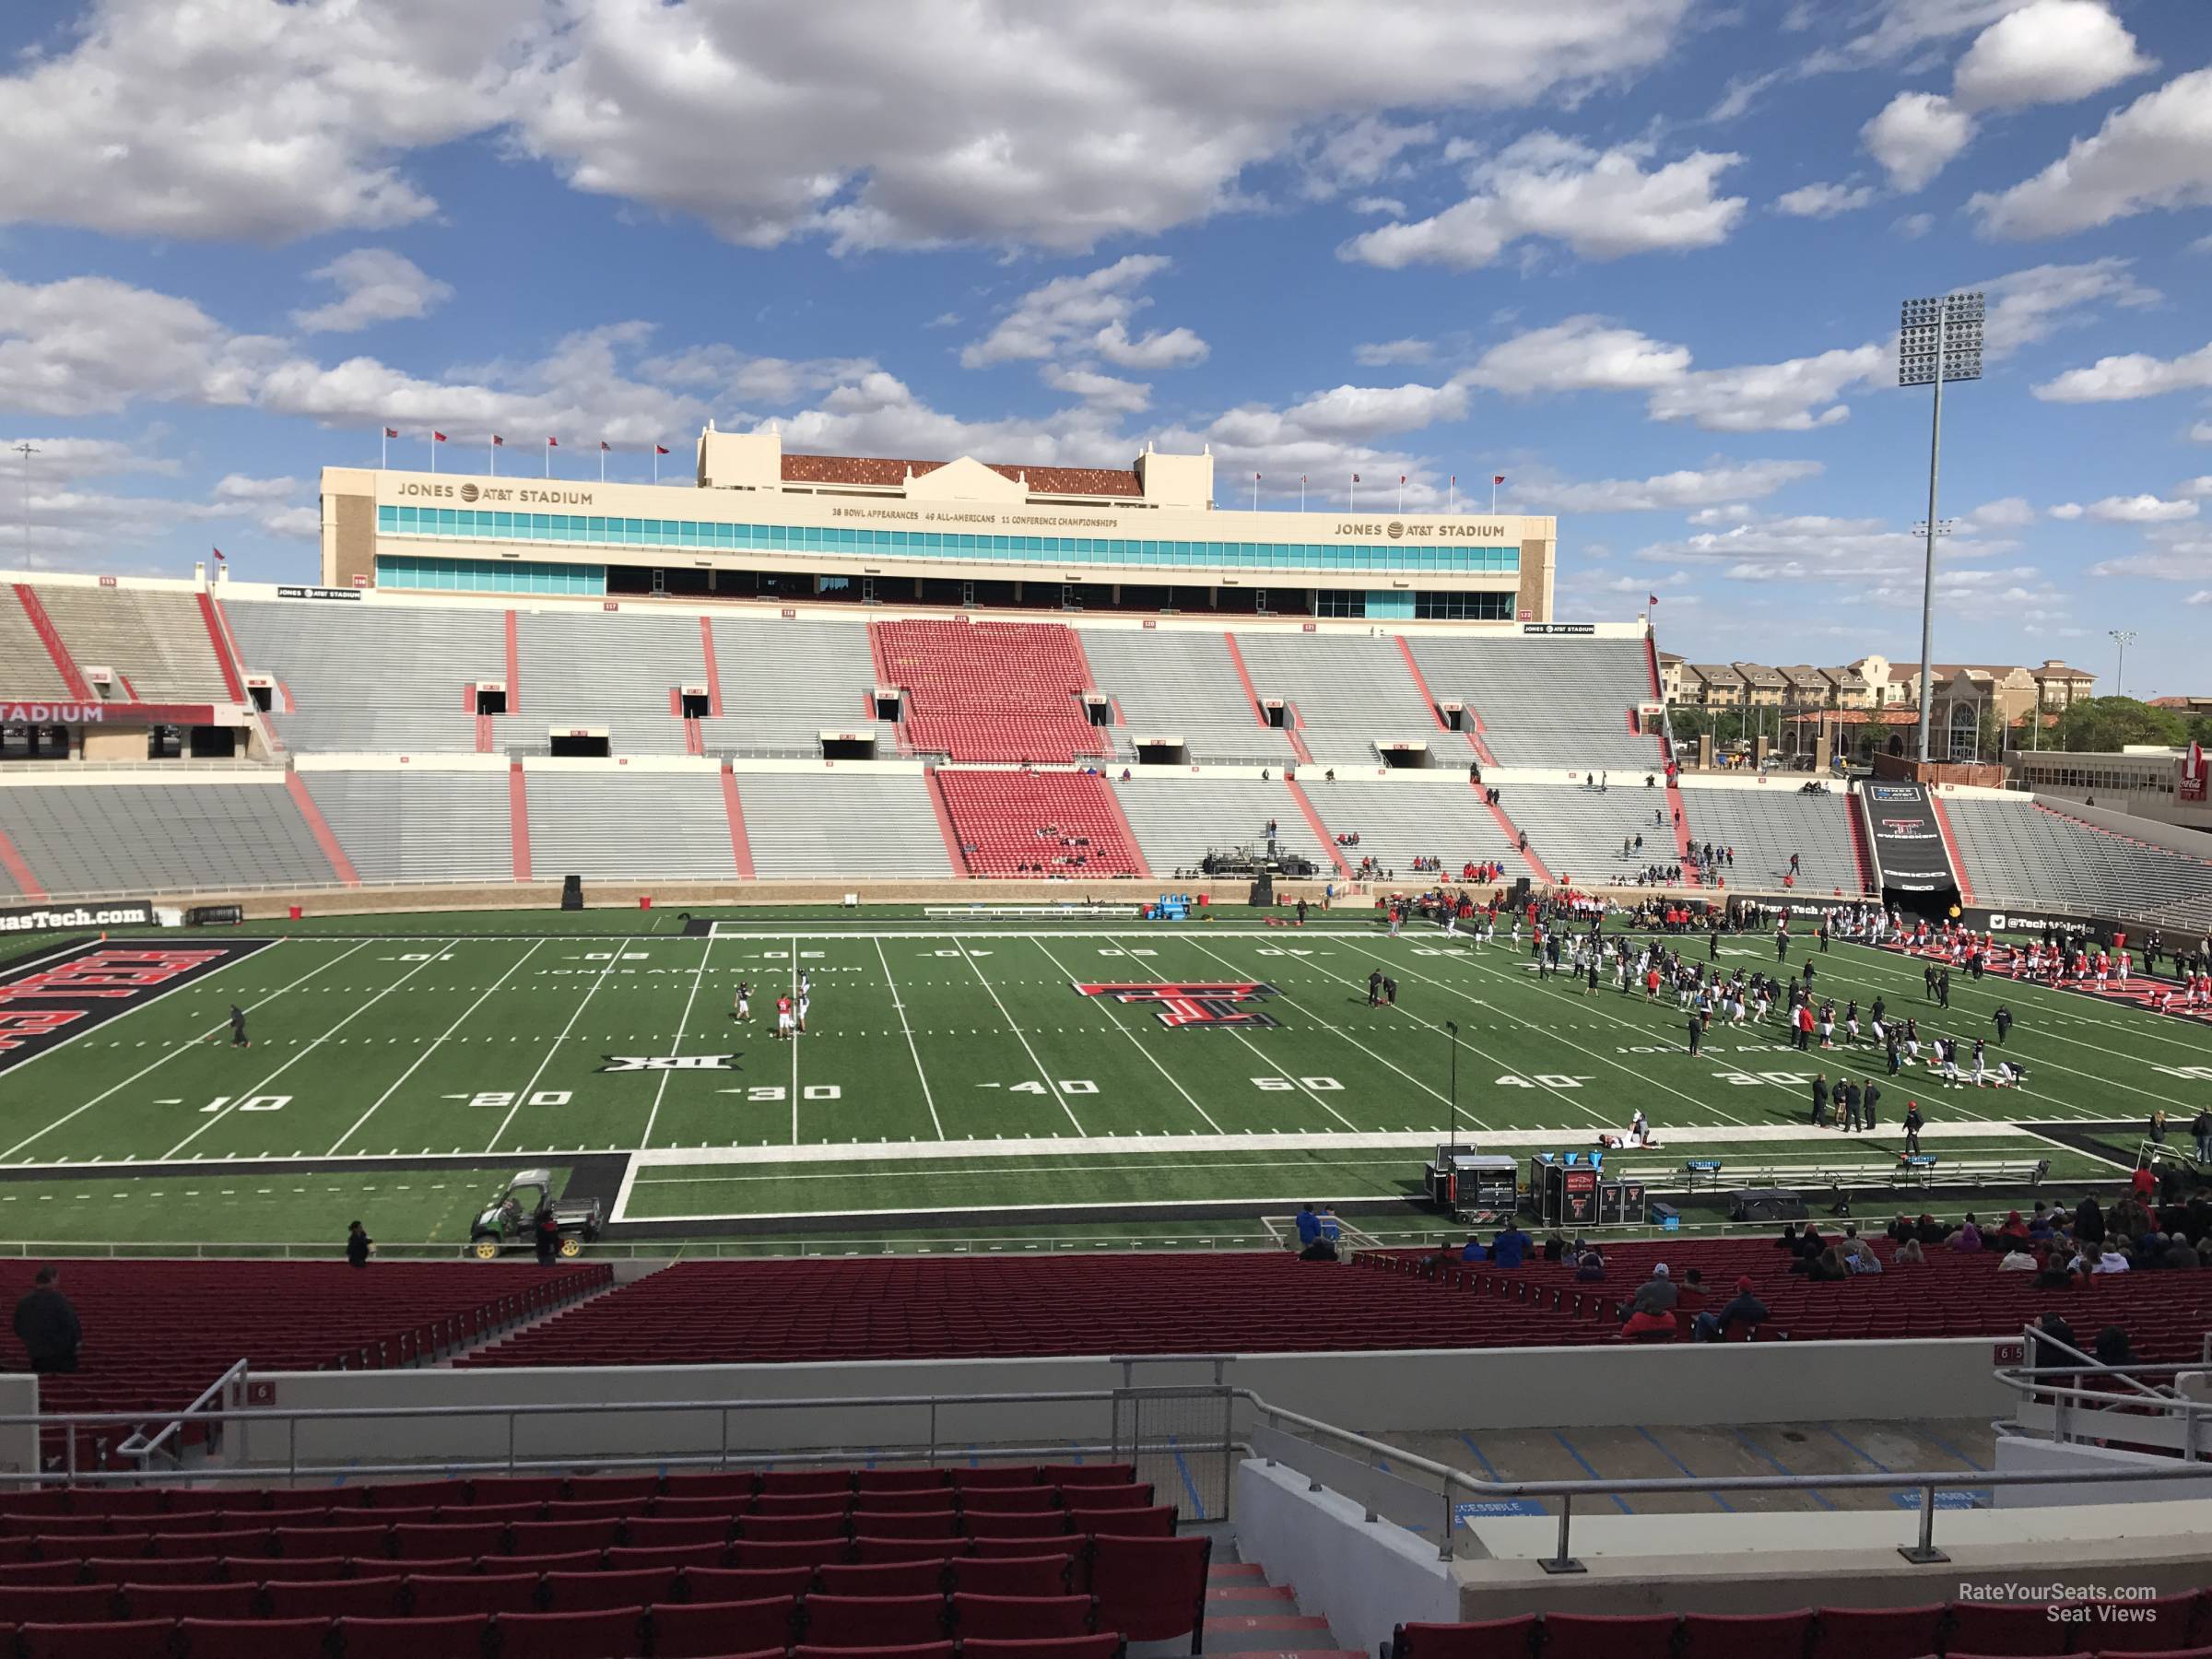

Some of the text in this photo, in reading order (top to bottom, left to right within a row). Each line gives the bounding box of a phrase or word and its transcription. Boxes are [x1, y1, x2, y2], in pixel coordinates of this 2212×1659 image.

[398, 483, 593, 505] JONES AT&T STADIUM
[832, 508, 919, 520] 38 BOWL APPEARANCES
[936, 513, 995, 523] ALL-AMERICANS
[1012, 516, 1057, 525] CONFERENCE
[1058, 518, 1118, 527] CHAMPIONSHIPS
[1335, 524, 1504, 537] JONES AT&T STADIUM
[1884, 869, 1947, 877] GEICO
[1791, 904, 1818, 914] Tech
[1250, 1077, 1346, 1090] 50
[1494, 1075, 1583, 1088] 40
[1712, 1072, 1810, 1085] 30
[747, 1086, 841, 1100] 30
[1008, 1080, 1100, 1094] 40
[199, 1095, 294, 1112] 10
[468, 1091, 573, 1106] 20
[2001, 1348, 2023, 1359] 6 5
[258, 1385, 266, 1398] 6
